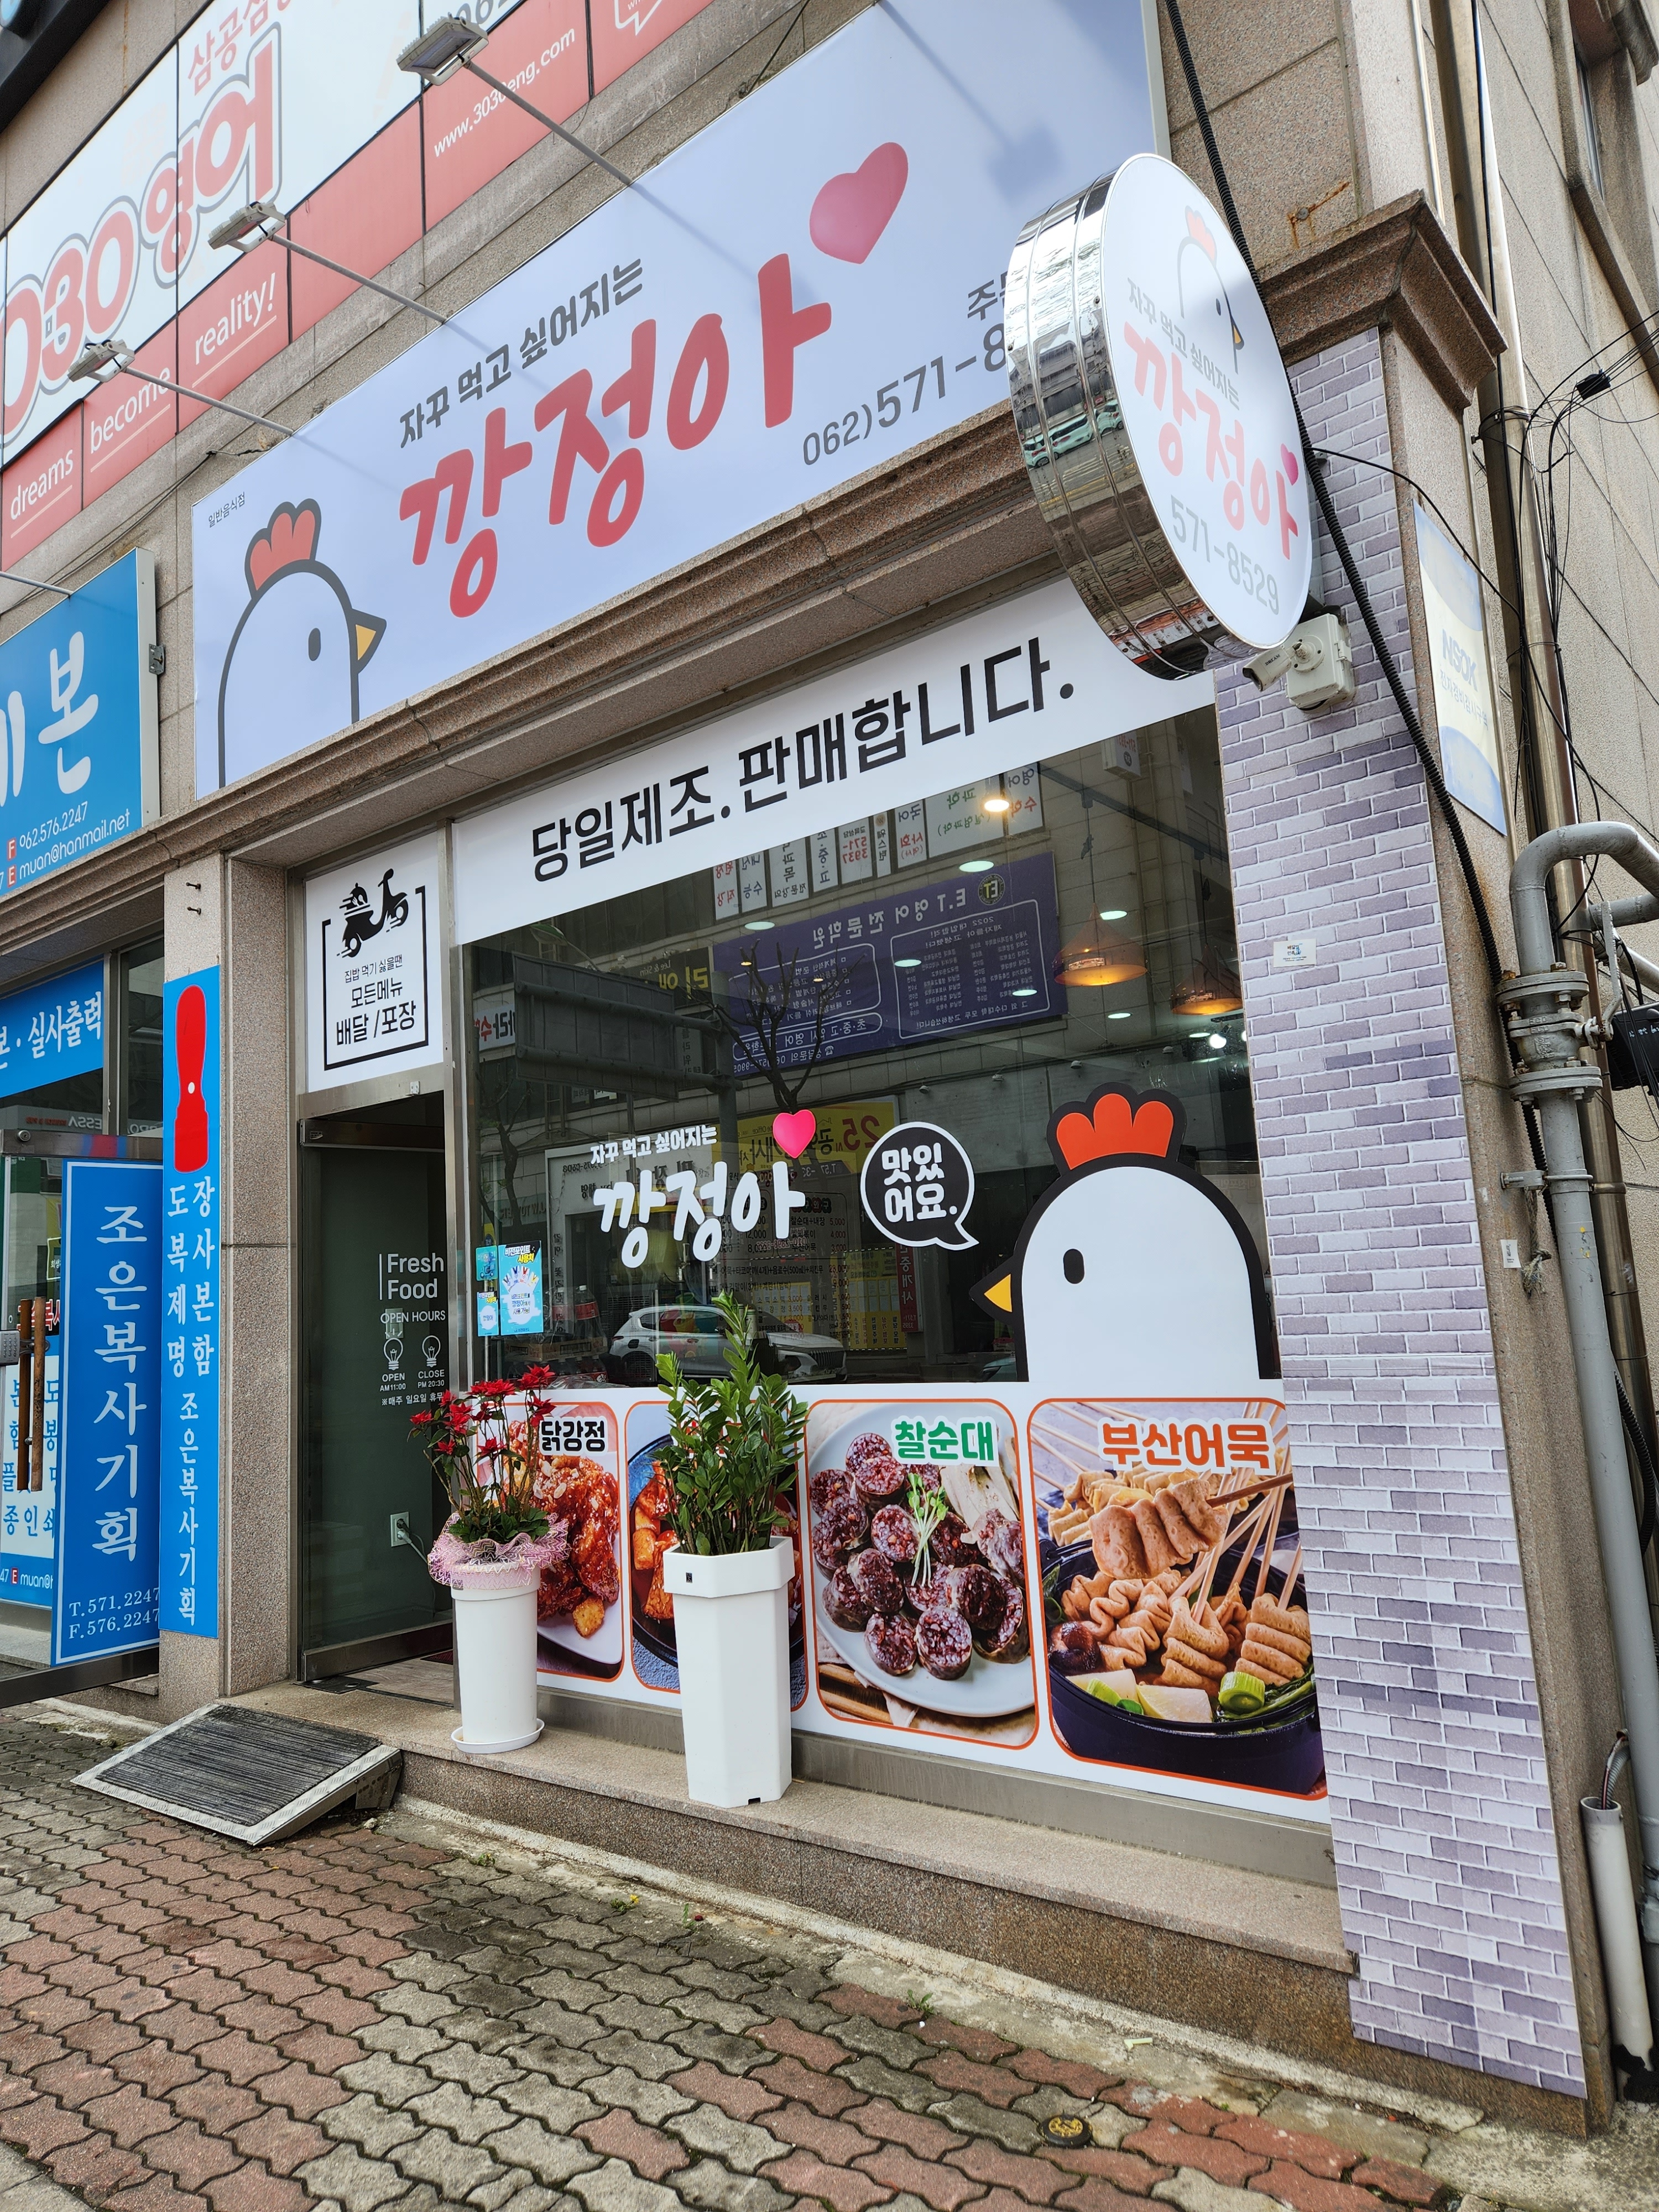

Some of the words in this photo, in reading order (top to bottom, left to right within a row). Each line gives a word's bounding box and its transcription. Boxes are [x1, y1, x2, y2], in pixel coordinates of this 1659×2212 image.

[187, 0, 291, 96] 삼공삼
[400, 387, 450, 448] 자꾸
[458, 344, 512, 404] 먹고
[520, 258, 643, 370] 싶어지는
[1127, 277, 1157, 325] 자꾸
[1160, 310, 1188, 359] 먹고
[1190, 342, 1240, 411] 싶어지는
[11, 448, 74, 520] dreams
[90, 368, 170, 454] become
[195, 273, 276, 365] reality!
[399, 253, 832, 618] 깡정아
[1124, 321, 1298, 560] 깡정아
[208, 492, 245, 528] 일반음식점
[1171, 495, 1279, 616] 571-8529
[1265, 653, 1281, 666] DREAM
[19, 801, 88, 851] 062.576.2247
[19, 807, 131, 880] muan@hanmail.net
[345, 967, 360, 983] 집밥
[361, 962, 377, 978] 먹기
[378, 954, 403, 973] 싫을땐
[351, 977, 403, 1009] 모든메뉴
[28, 991, 102, 1060] 실사출력
[336, 1013, 369, 1046] 배달
[589, 1145, 618, 1165] 자꾸
[622, 1136, 650, 1158] 먹고
[655, 1124, 717, 1152] 싶어지는
[881, 1142, 945, 1186] 맛있
[167, 1176, 215, 1218] 도장
[593, 1161, 805, 1268] 깡정아
[167, 1228, 215, 1272] 복사
[388, 1253, 444, 1274] Fresh
[167, 1281, 215, 1326] 제본
[388, 1278, 437, 1300] Food
[380, 1312, 409, 1324] OPEN
[412, 1310, 446, 1322] HOURS
[167, 1334, 215, 1378] 명함
[382, 1373, 405, 1383] OPEN
[418, 1369, 445, 1379] CLOSE
[92, 1206, 148, 1562] 조은복사기획
[406, 1393, 427, 1404] 일요일
[541, 1421, 606, 1452] 닭강정
[894, 1420, 995, 1463] 찰순대
[1103, 1422, 1272, 1471] 부산어묵
